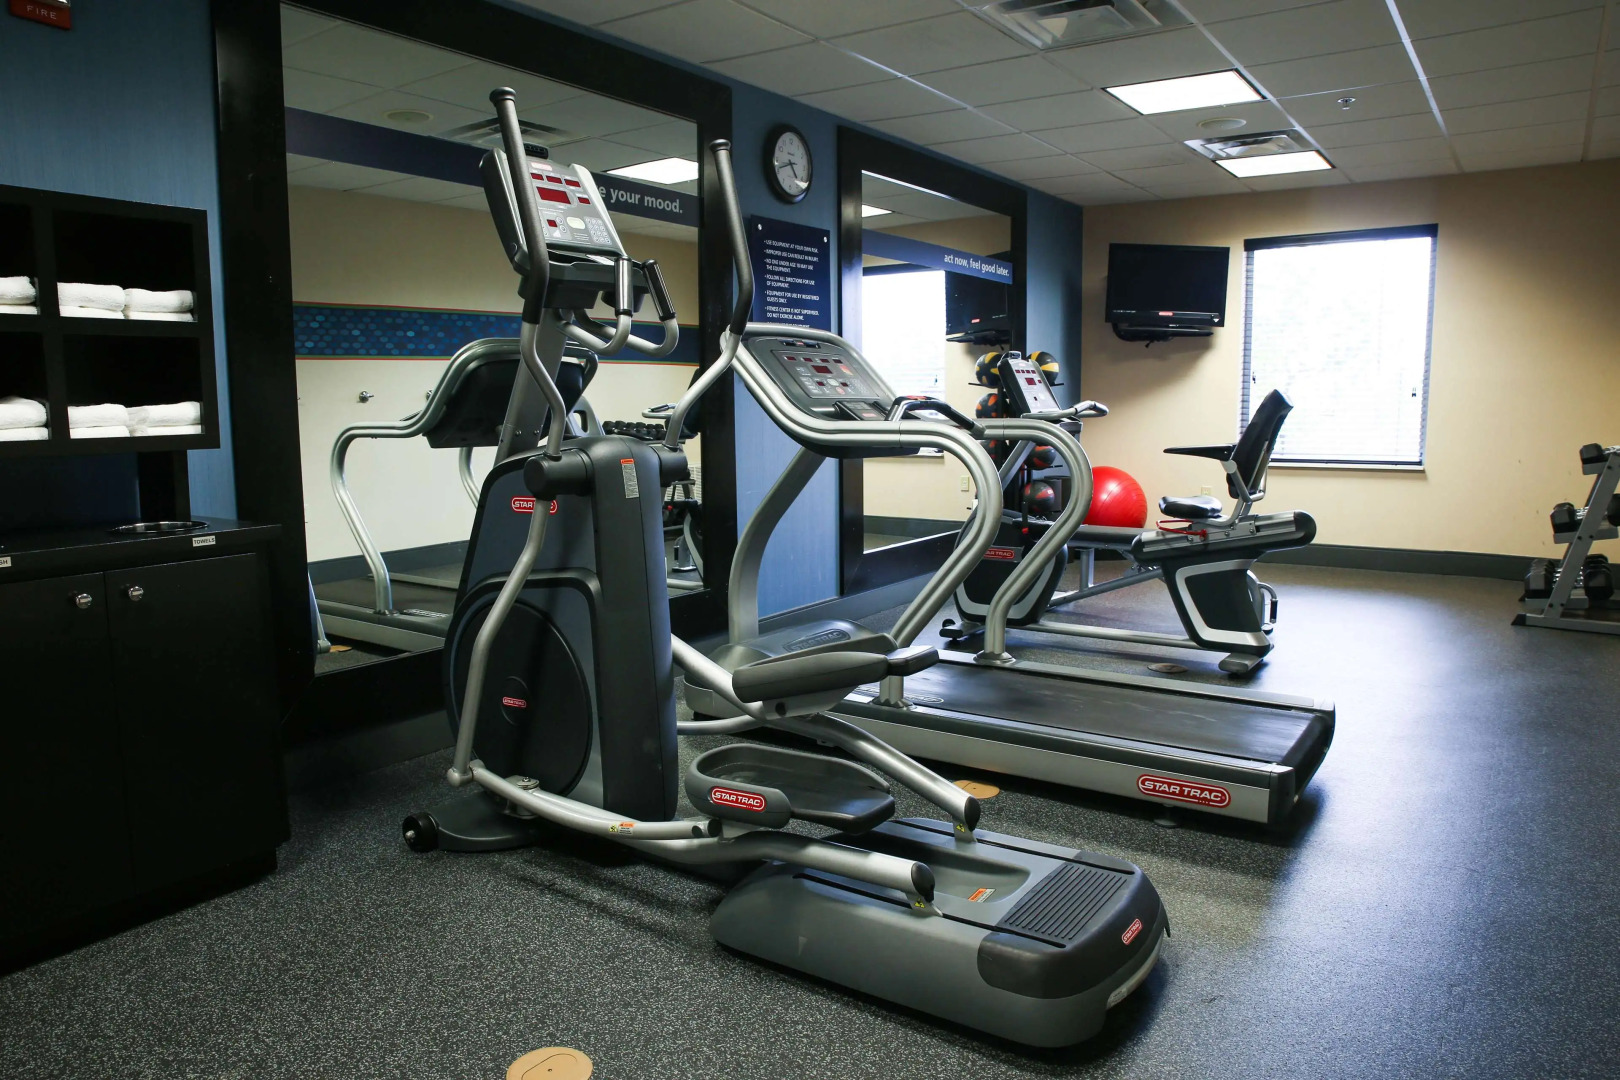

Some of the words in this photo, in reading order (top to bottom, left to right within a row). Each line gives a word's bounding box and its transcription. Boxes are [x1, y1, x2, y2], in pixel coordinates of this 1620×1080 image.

[26, 5, 57, 20] FIRE
[597, 185, 606, 198] e
[610, 188, 640, 204] your
[644, 195, 683, 214] mood.
[944, 254, 954, 264] act
[954, 256, 968, 268] now,
[970, 258, 980, 270] feel
[982, 263, 996, 273] good
[996, 264, 1010, 276] later.
[790, 638, 816, 652] STAR
[816, 632, 842, 644] TRAC
[715, 792, 737, 802] STAR
[737, 796, 761, 806] TRAC
[1144, 780, 1180, 794] STAR
[1182, 786, 1222, 801] TRAC
